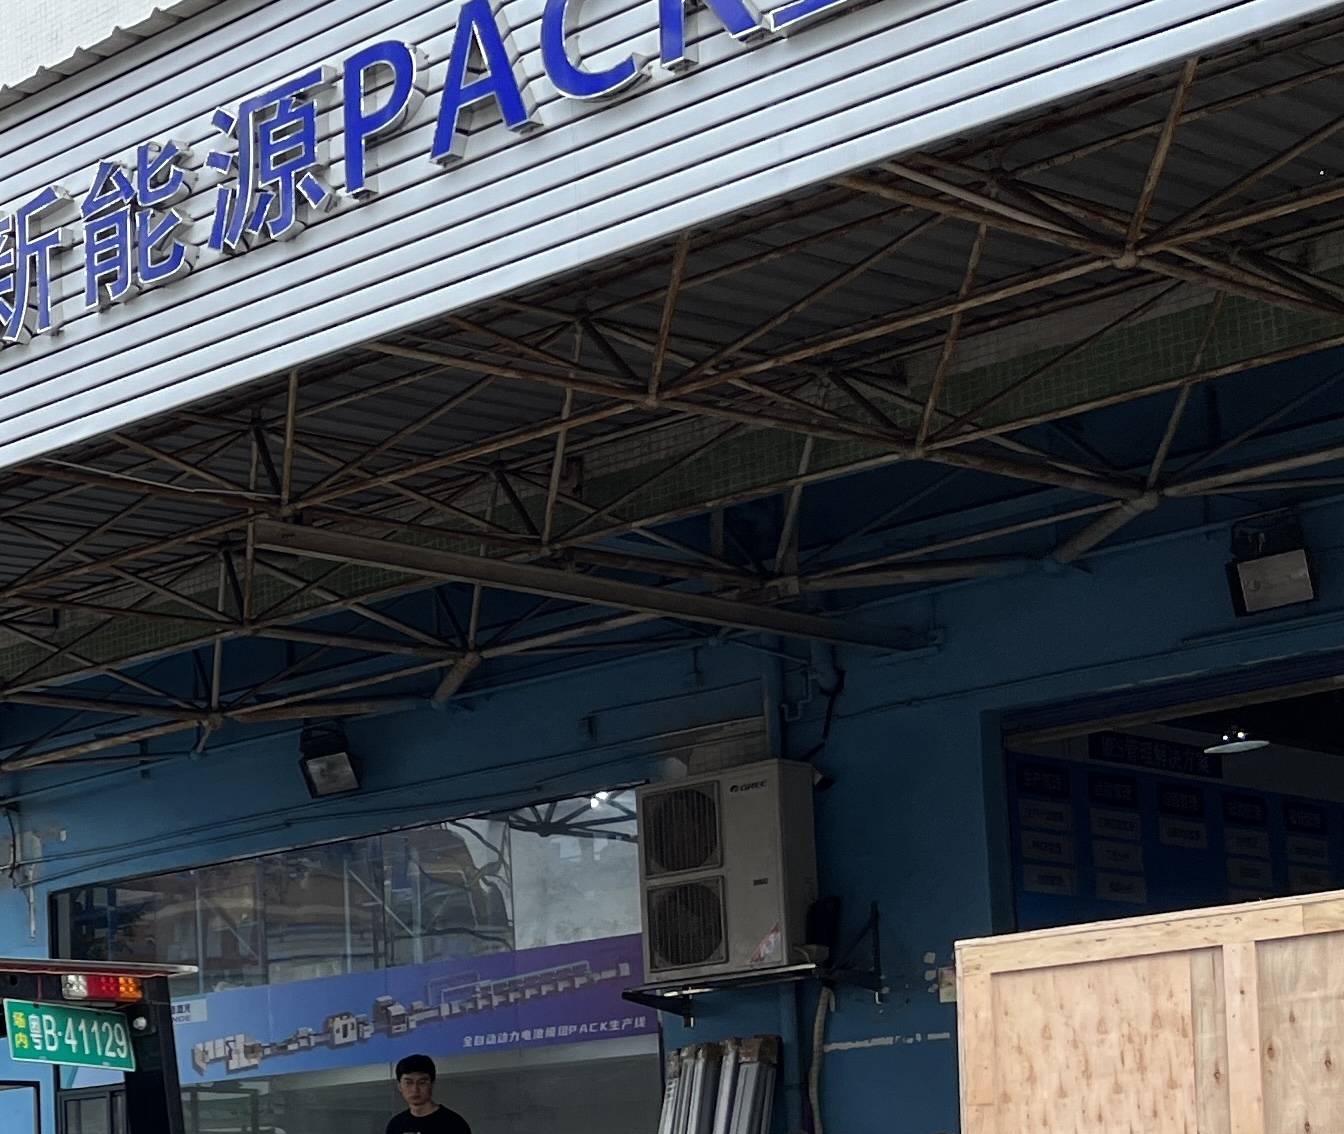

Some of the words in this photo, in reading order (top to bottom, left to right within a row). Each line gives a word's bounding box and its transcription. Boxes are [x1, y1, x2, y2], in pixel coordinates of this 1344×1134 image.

[463, 1016, 647, 1048] 全自动动力电池模组PACK生产线
